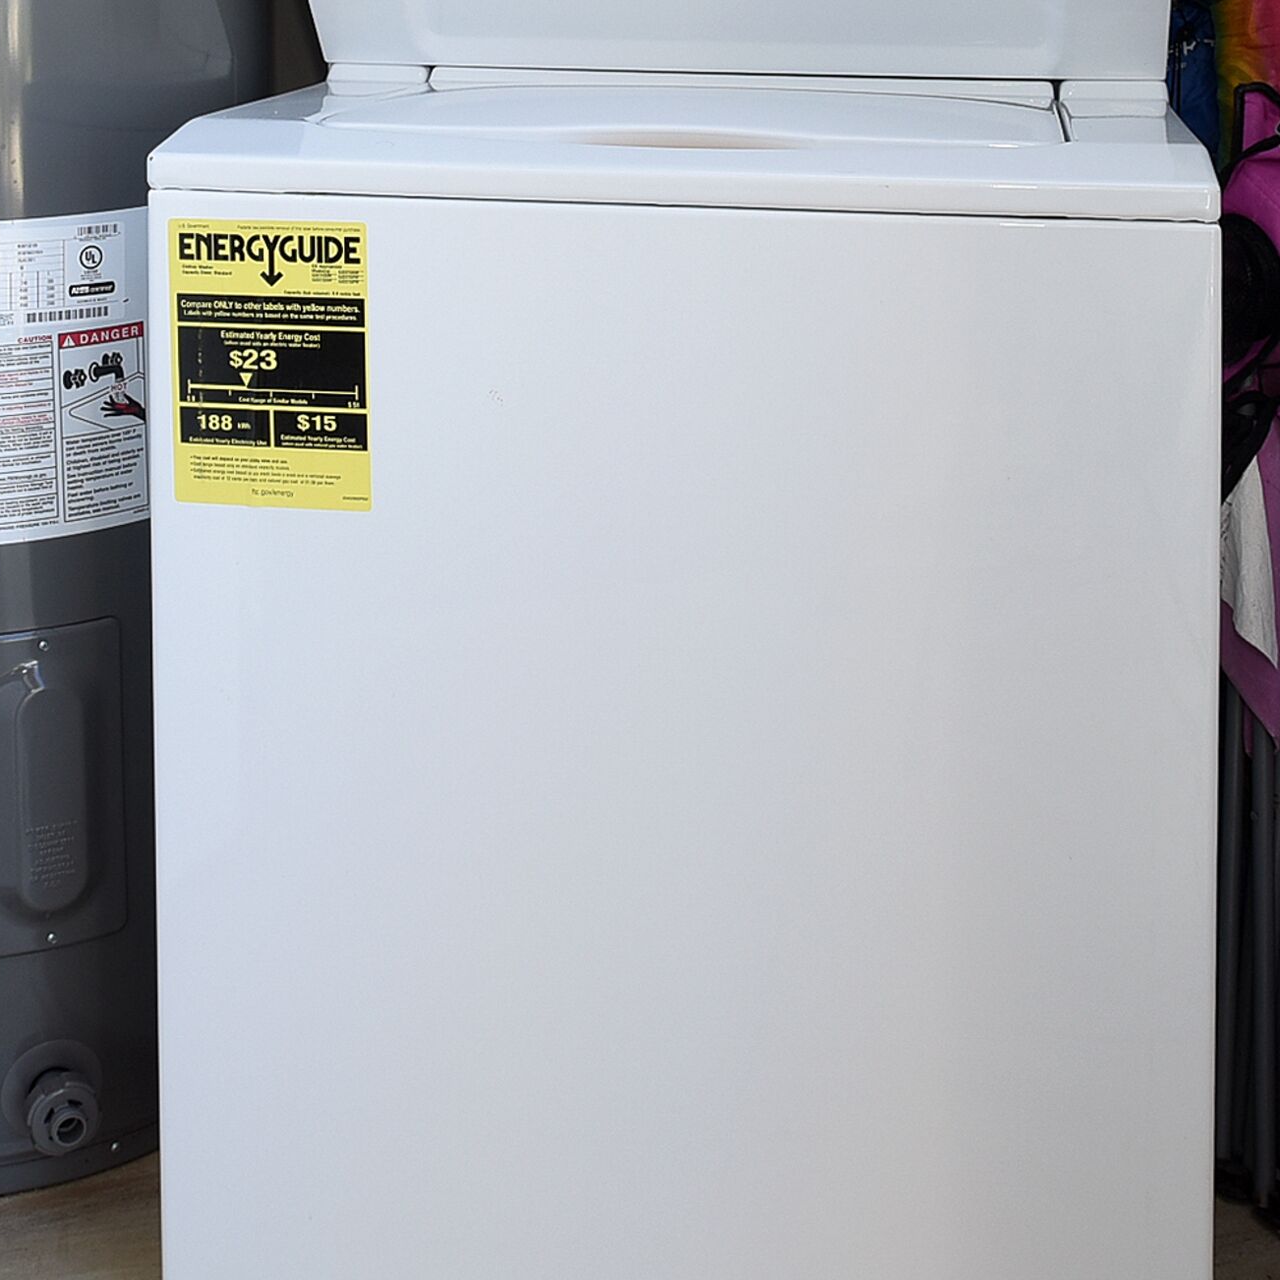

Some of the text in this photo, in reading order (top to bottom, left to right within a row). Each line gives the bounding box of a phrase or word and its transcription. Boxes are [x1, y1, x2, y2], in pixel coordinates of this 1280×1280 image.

[179, 233, 361, 264] ENERGYGUIDE
[85, 250, 97, 265] UL
[180, 299, 360, 313] Compare ONLY to other labels with yellow numbers.
[17, 334, 53, 344] CAUTION
[80, 326, 139, 344] DANGER
[221, 330, 321, 342] Estimated Yearly Energy Cost
[229, 349, 278, 370] $23
[111, 383, 127, 391] HOT
[197, 414, 251, 431] 188 kWh
[297, 415, 337, 432] $15
[216, 437, 230, 445] Yearly
[232, 438, 255, 446] Electricity
[280, 434, 306, 442] Estimated
[307, 435, 323, 443] Yearly
[324, 436, 342, 444] Energy
